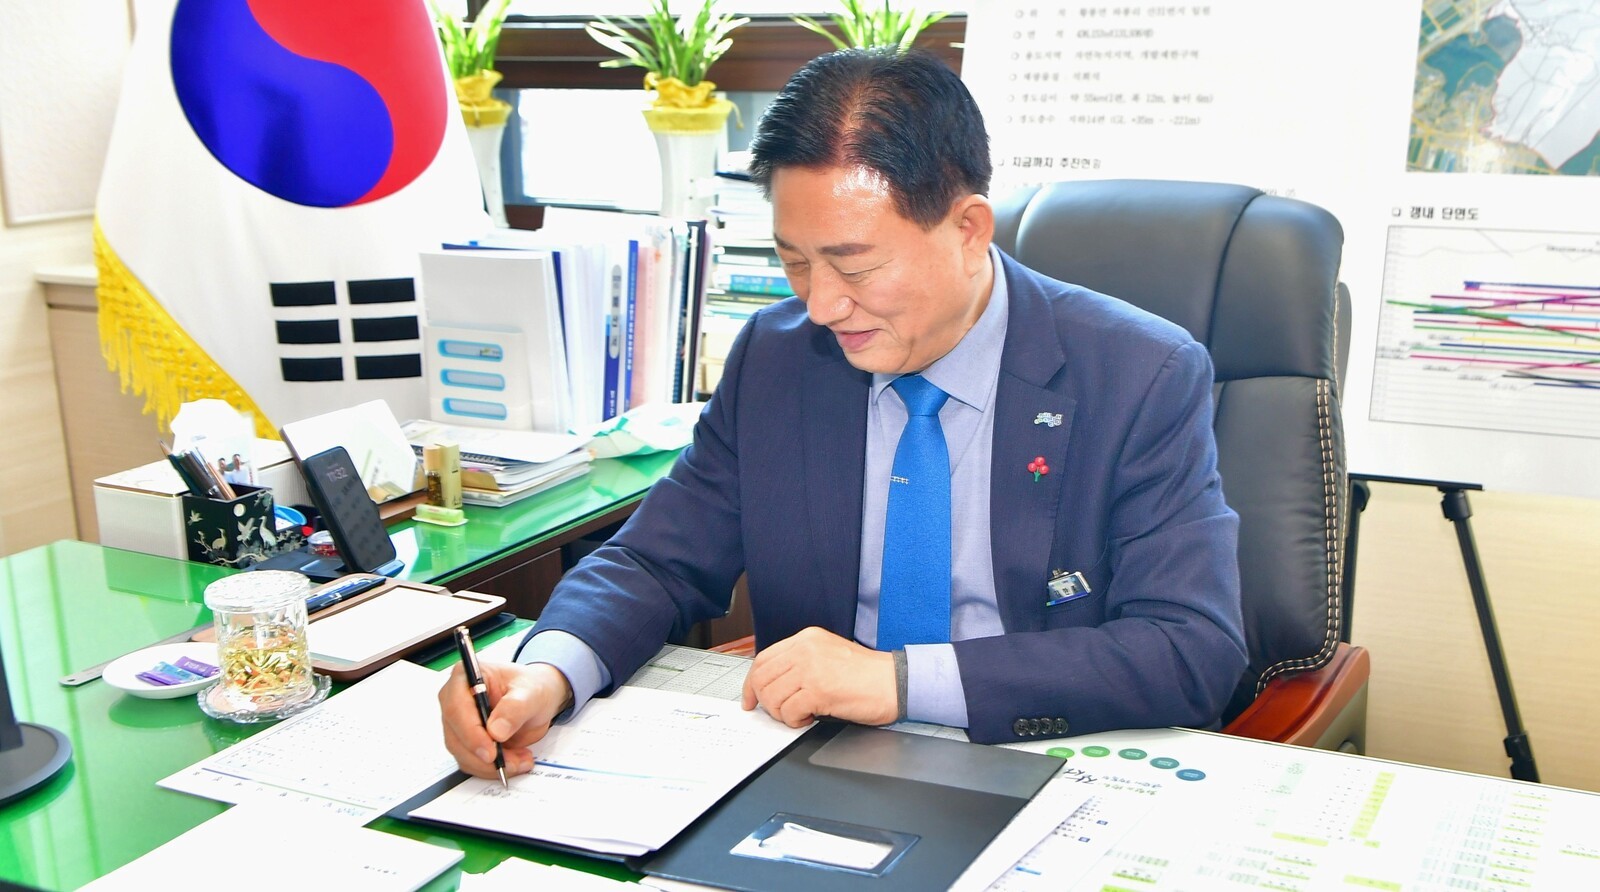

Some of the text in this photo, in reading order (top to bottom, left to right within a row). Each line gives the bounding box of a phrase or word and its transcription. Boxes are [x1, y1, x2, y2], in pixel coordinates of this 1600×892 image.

[1012, 156, 1054, 169] 지금까지
[1410, 205, 1478, 221] 갱내 단면도
